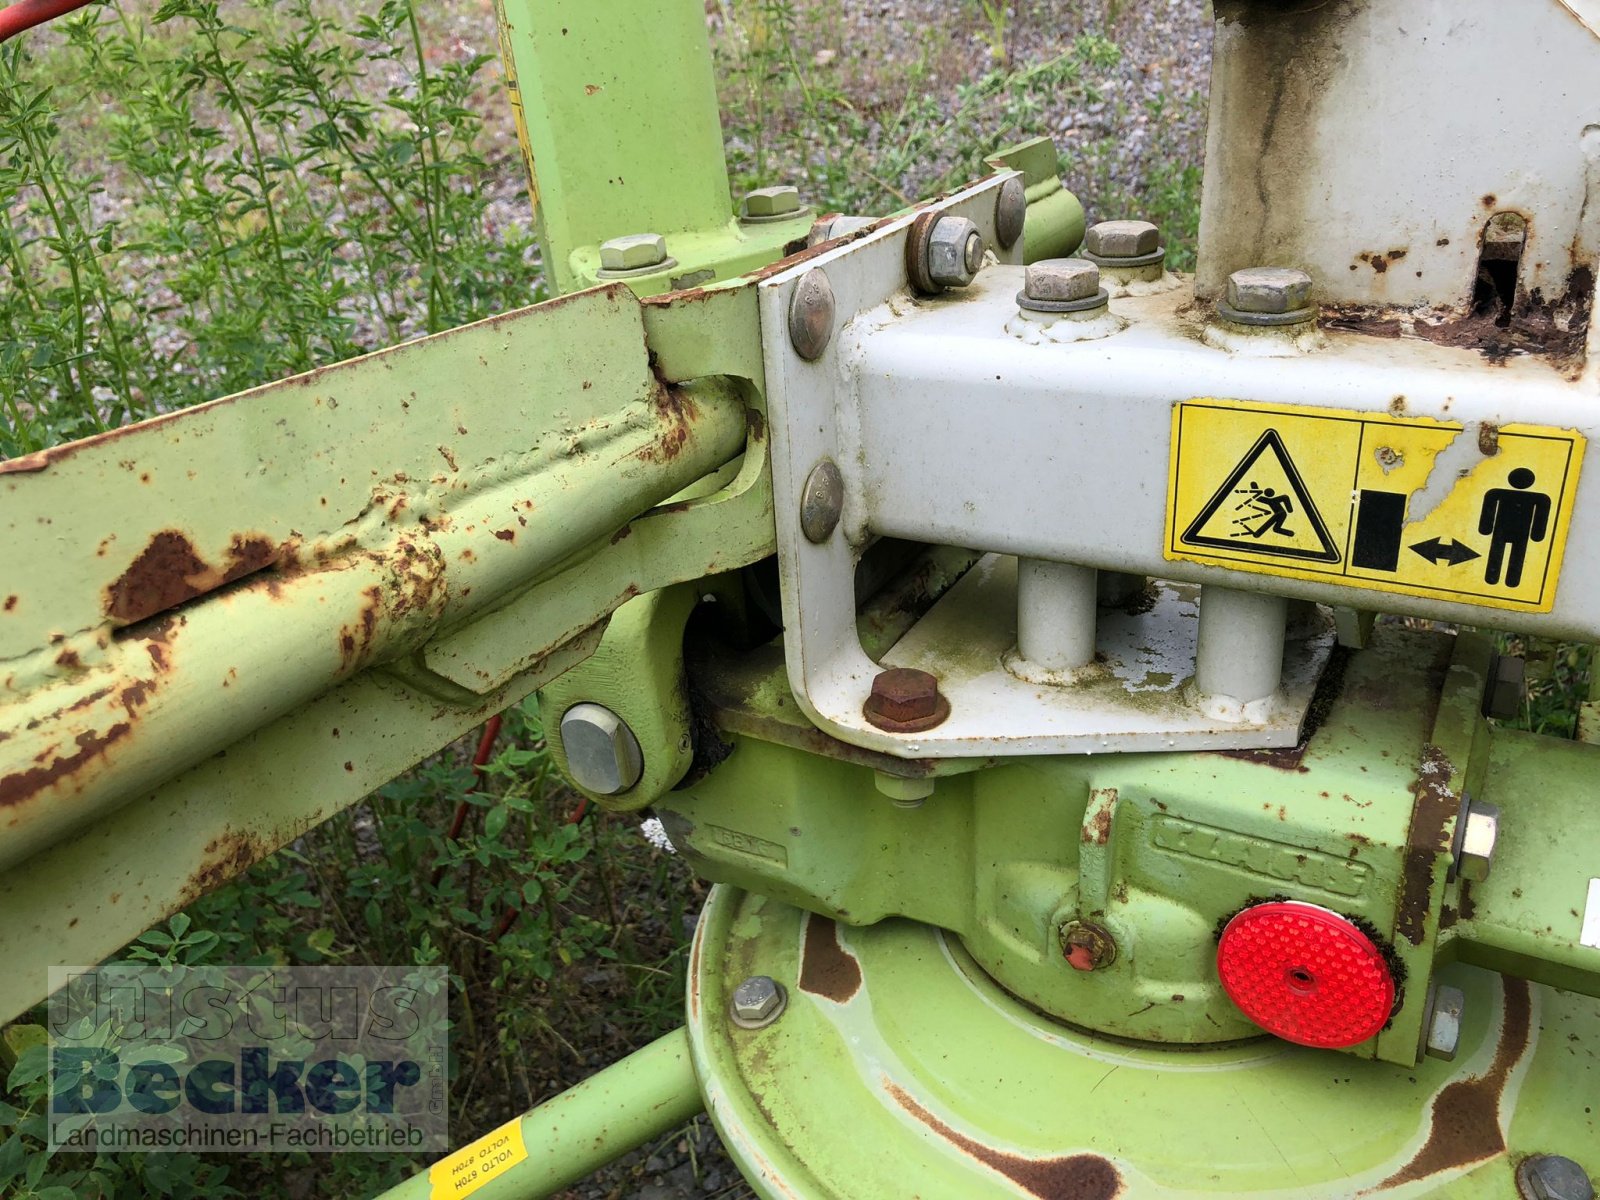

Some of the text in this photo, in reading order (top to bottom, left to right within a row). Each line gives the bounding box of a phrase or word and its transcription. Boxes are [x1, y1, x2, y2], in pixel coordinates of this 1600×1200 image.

[479, 1136, 510, 1158] VOLTO
[454, 1149, 512, 1190] VOLTO 670H
